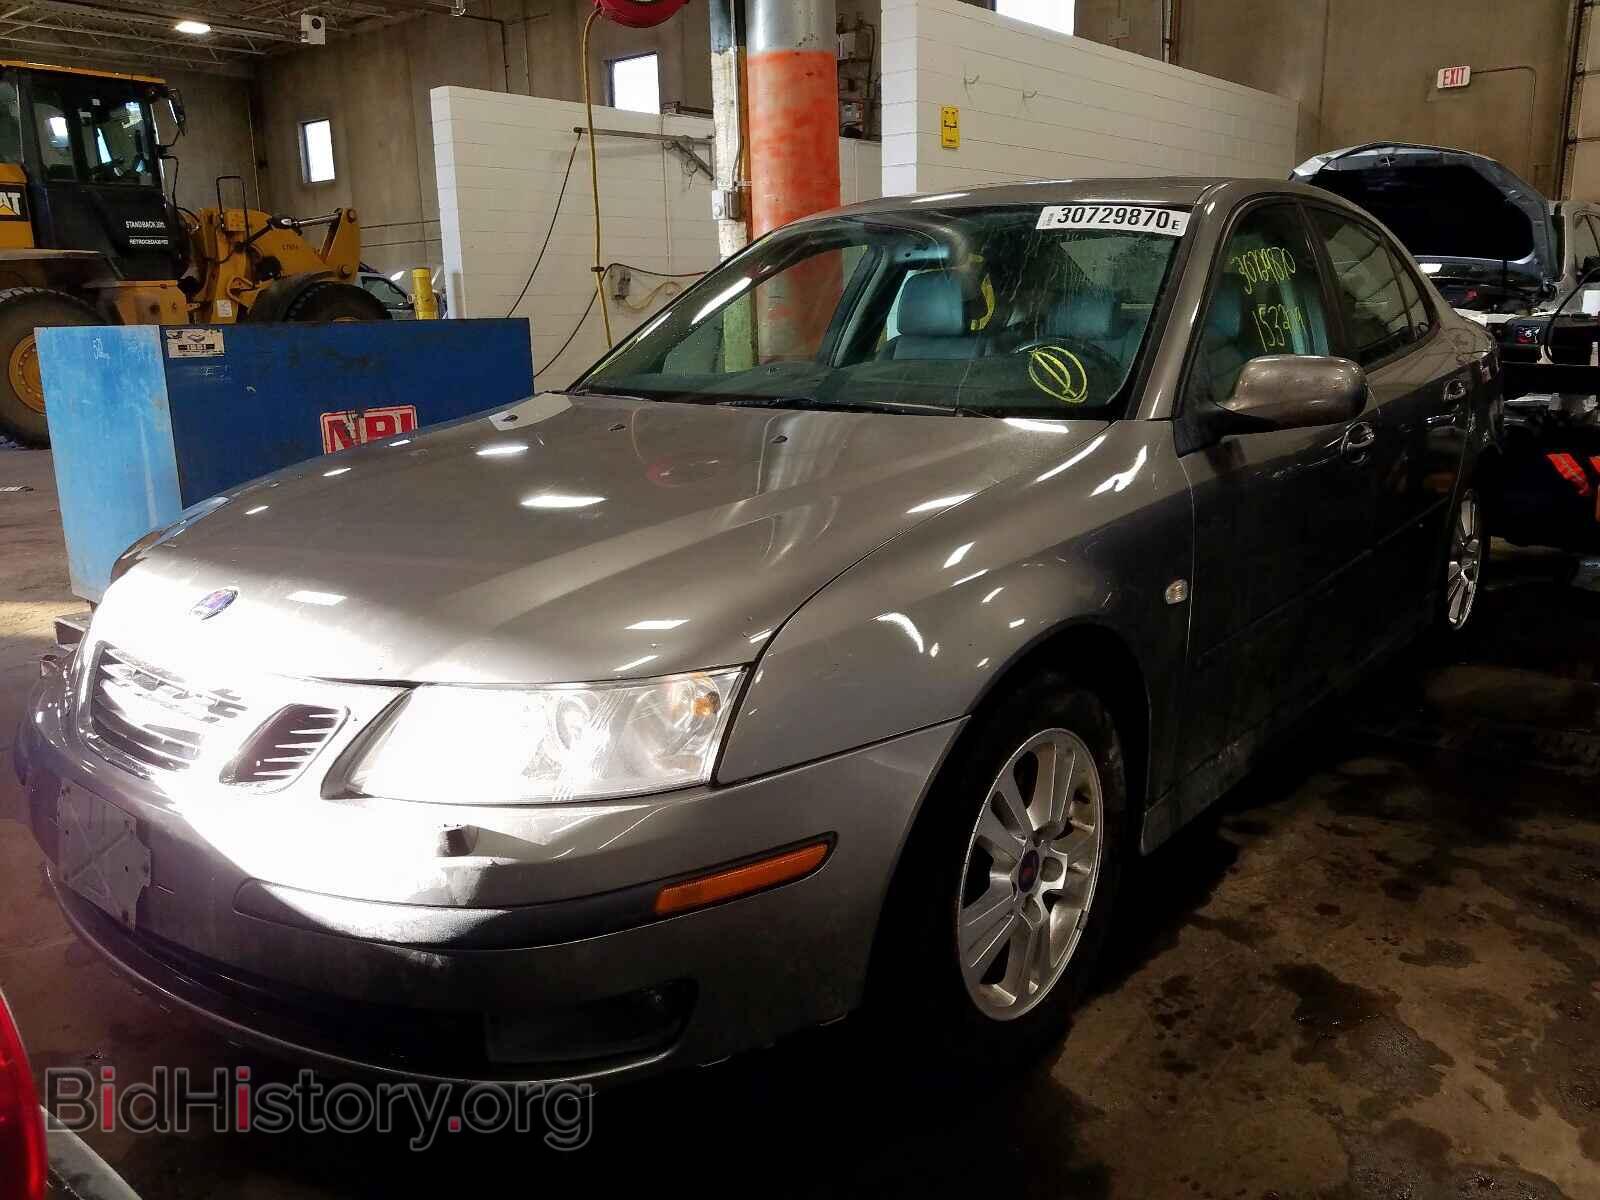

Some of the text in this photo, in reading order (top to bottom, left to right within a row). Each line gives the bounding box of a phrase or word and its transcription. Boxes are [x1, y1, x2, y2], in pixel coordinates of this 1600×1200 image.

[1443, 68, 1465, 86] EXIT
[0, 192, 21, 216] AT
[1057, 206, 1170, 229] 30729870
[1171, 219, 1181, 230] E
